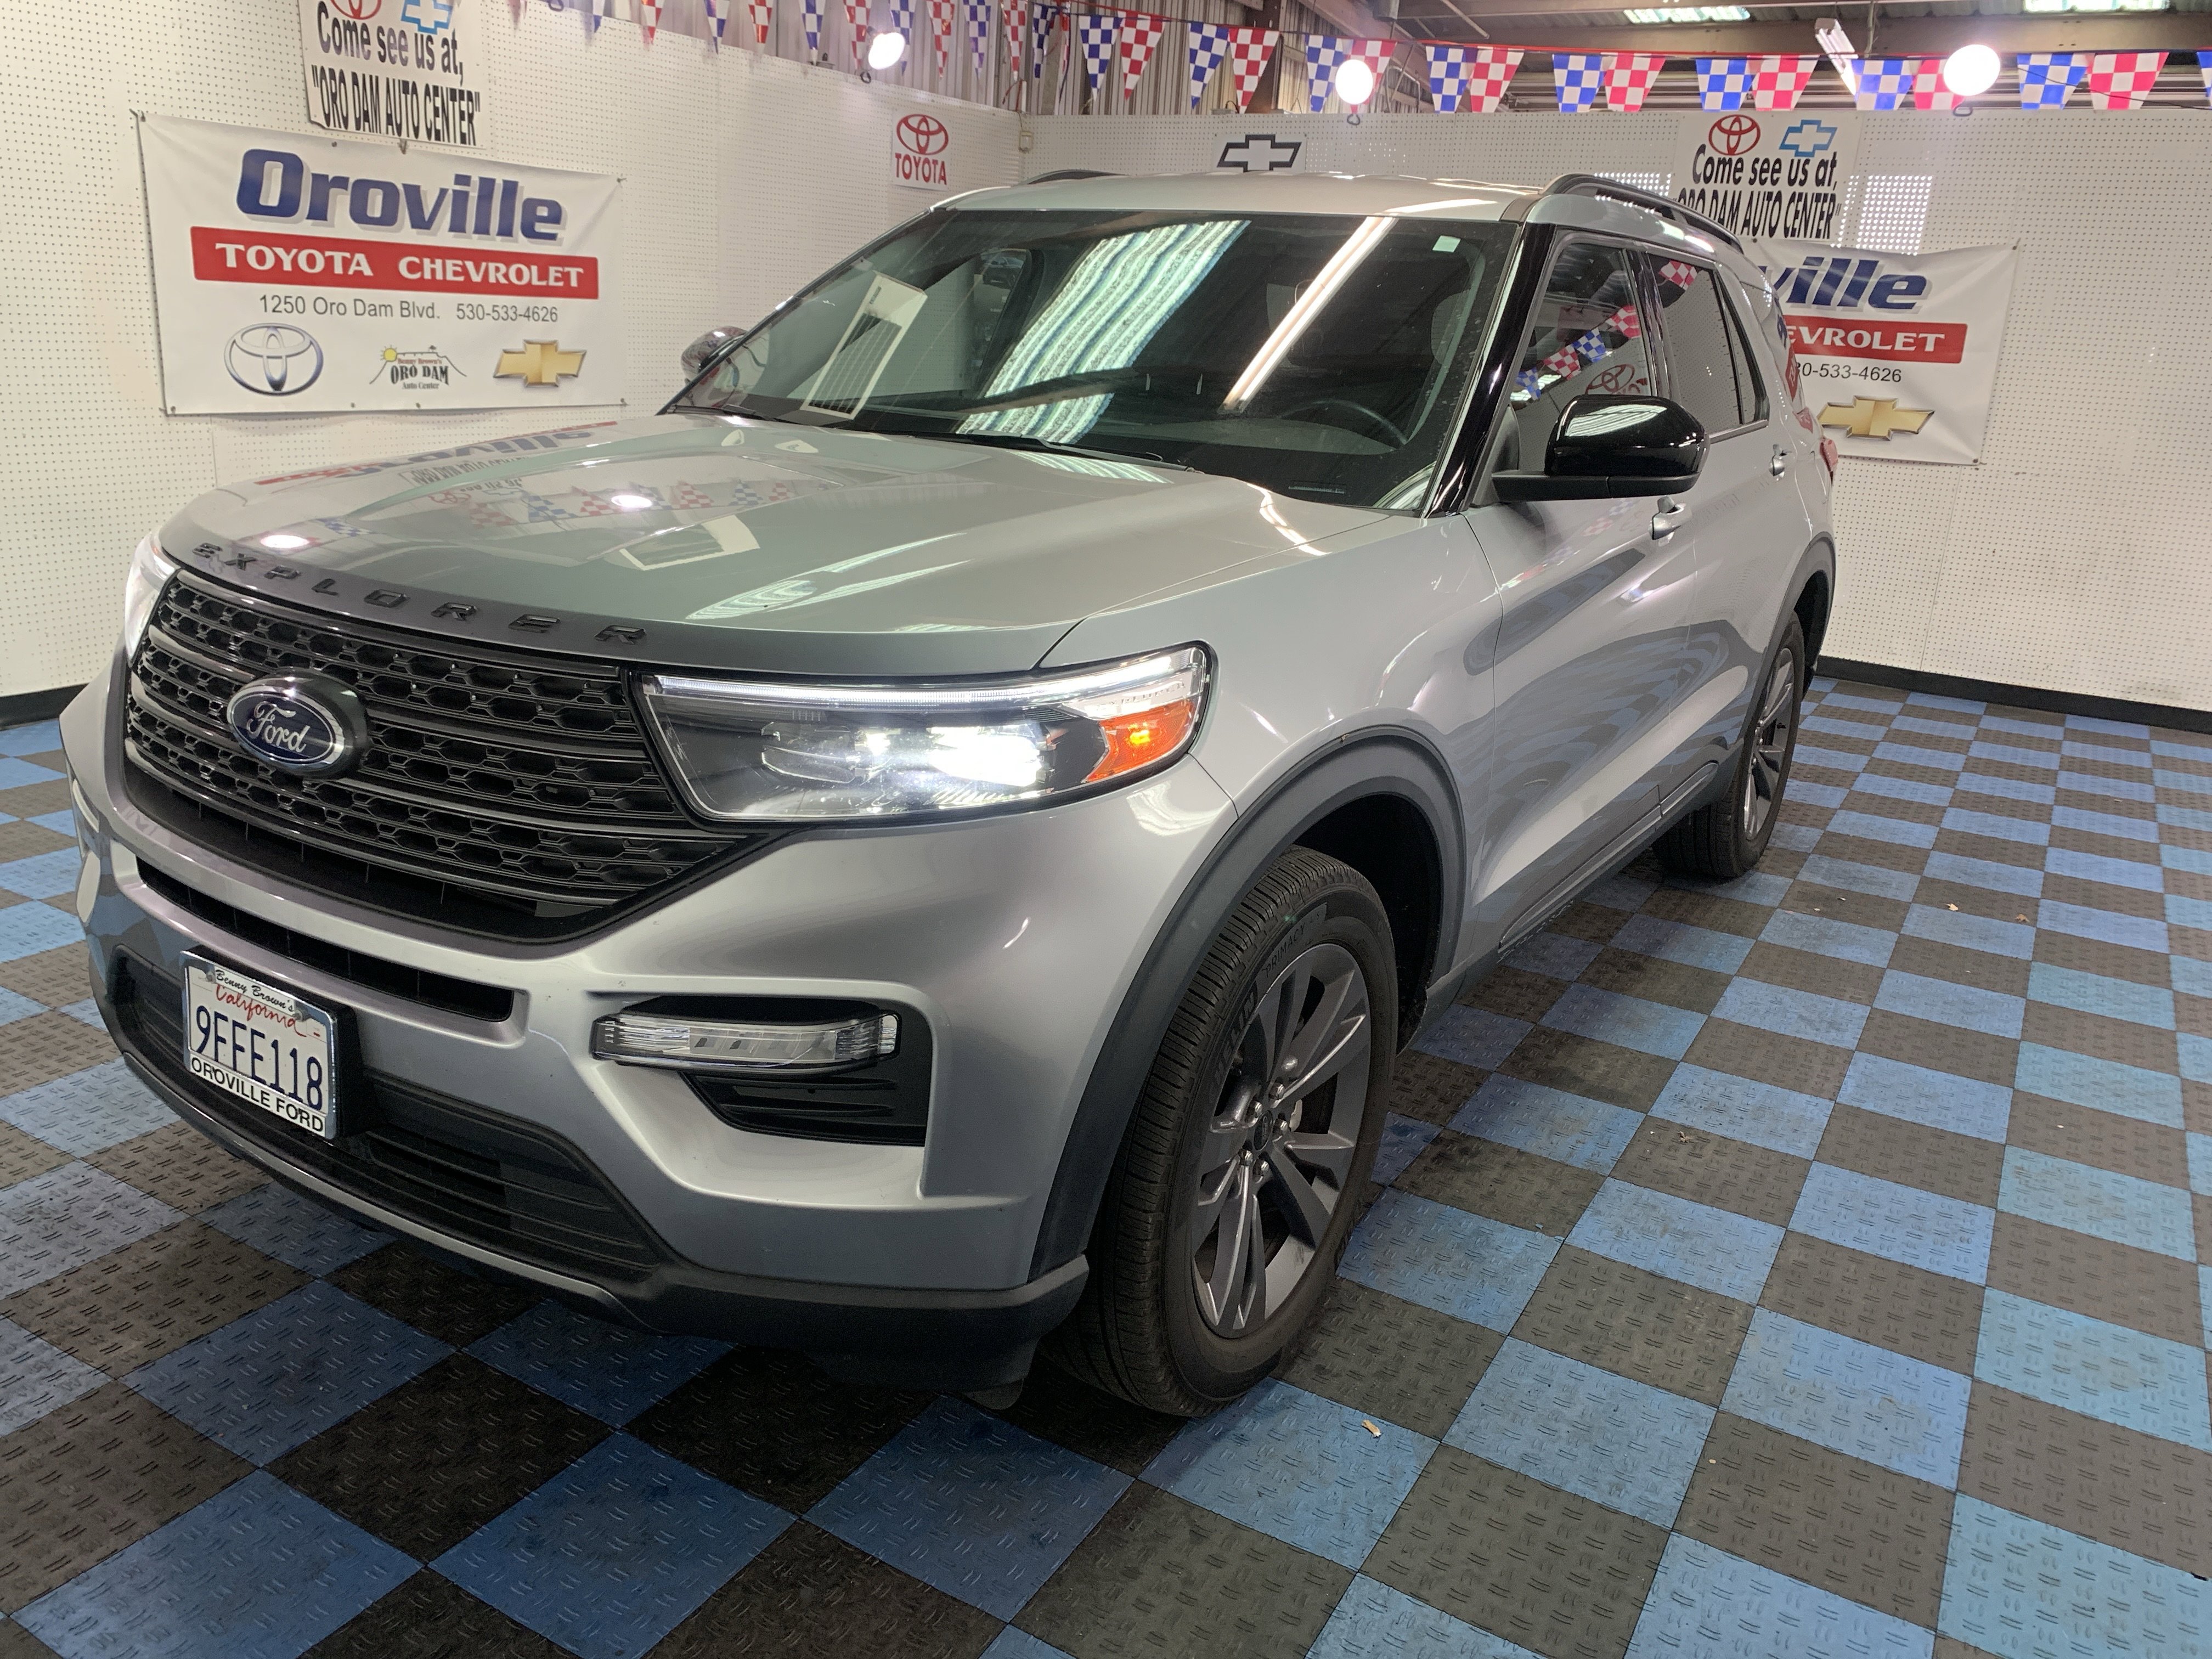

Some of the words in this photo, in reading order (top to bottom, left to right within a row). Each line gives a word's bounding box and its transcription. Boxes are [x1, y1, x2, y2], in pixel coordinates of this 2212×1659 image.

[317, 1, 371, 60] Come
[377, 25, 409, 66] see
[414, 32, 435, 71] us
[441, 27, 464, 87] at,
[311, 64, 349, 130] "ORO
[351, 71, 382, 134] DAM
[386, 76, 420, 139] AUTO
[424, 83, 481, 146] CENTER"
[895, 153, 947, 185] TOYOTA
[1692, 143, 1745, 185] Come
[1748, 156, 1782, 186] see
[1787, 158, 1810, 187] us
[1815, 151, 1838, 191] at,
[236, 148, 563, 241] Oroville
[1741, 190, 1784, 238] AUTO
[1784, 191, 1842, 240] CENTER"
[215, 242, 374, 276] TOYOTA
[398, 256, 585, 287] CHEVROLET
[259, 295, 306, 314] 1250
[313, 297, 347, 316] Oro
[354, 298, 394, 318] Dam
[400, 300, 440, 319] Blvd.
[456, 303, 558, 323] 530-533-4626
[390, 365, 418, 385] ORO
[422, 365, 449, 386] DAM
[192, 541, 647, 646] EXPLORER
[246, 701, 307, 754] Ford
[1261, 922, 1306, 979] PRIMACY
[215, 969, 247, 994] Benny
[251, 984, 294, 1013] Brown's
[216, 984, 307, 1037] California
[195, 1005, 323, 1111] 9FFE118
[191, 1057, 271, 1109] OROVILLE
[276, 1102, 324, 1132] FORD
